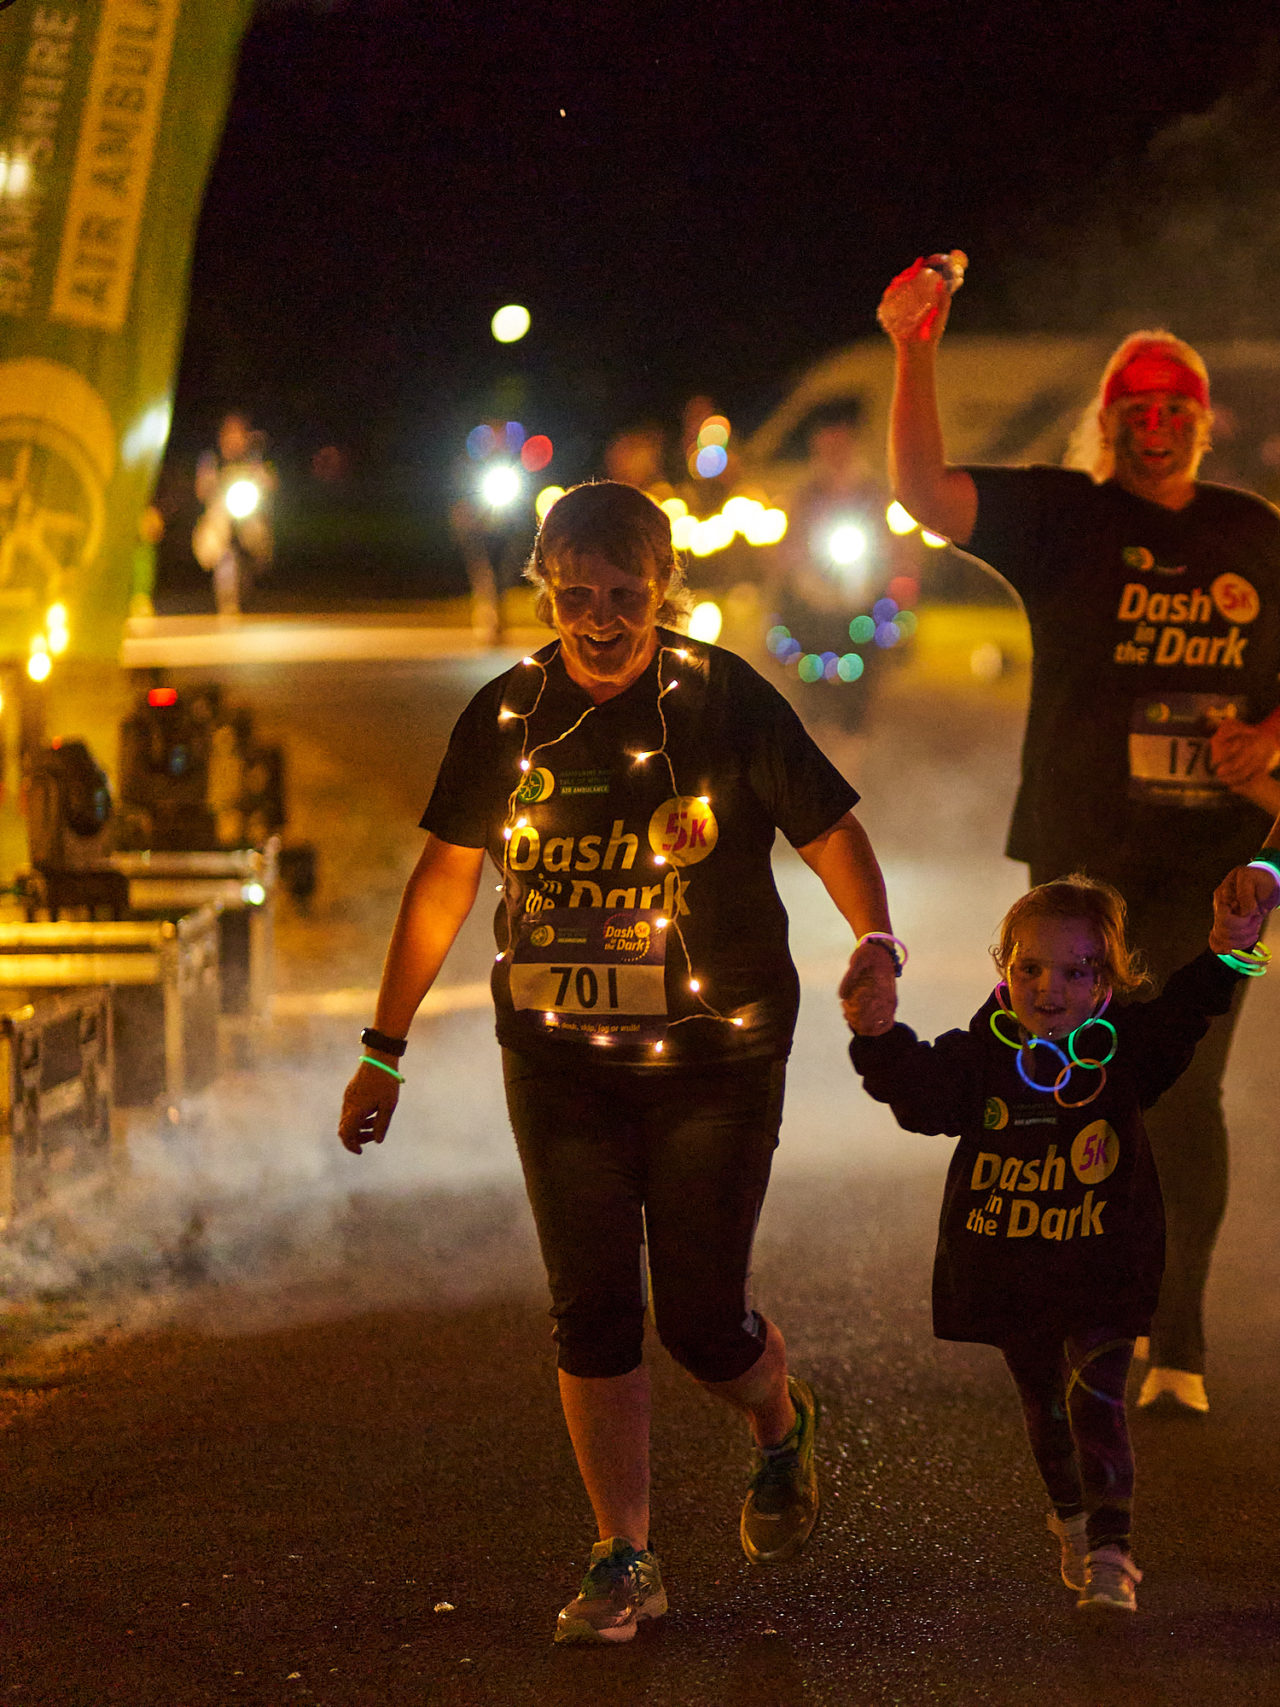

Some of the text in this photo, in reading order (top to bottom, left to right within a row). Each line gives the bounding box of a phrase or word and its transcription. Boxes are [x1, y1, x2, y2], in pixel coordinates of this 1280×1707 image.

[70, 0, 160, 305] AIR AMBUL
[1117, 582, 1253, 624] Dash 5K
[1113, 626, 1248, 668] the Dark
[1134, 620, 1156, 645] in
[508, 812, 709, 872] Dash 5K
[539, 873, 562, 895] in
[568, 871, 691, 917] Dark
[605, 924, 634, 939] Dash
[616, 938, 645, 951] Dark
[550, 966, 619, 1009] 701
[970, 1134, 1111, 1192] Dash 5K
[966, 1190, 1108, 1241] the Dark
[985, 1188, 1003, 1215] in
